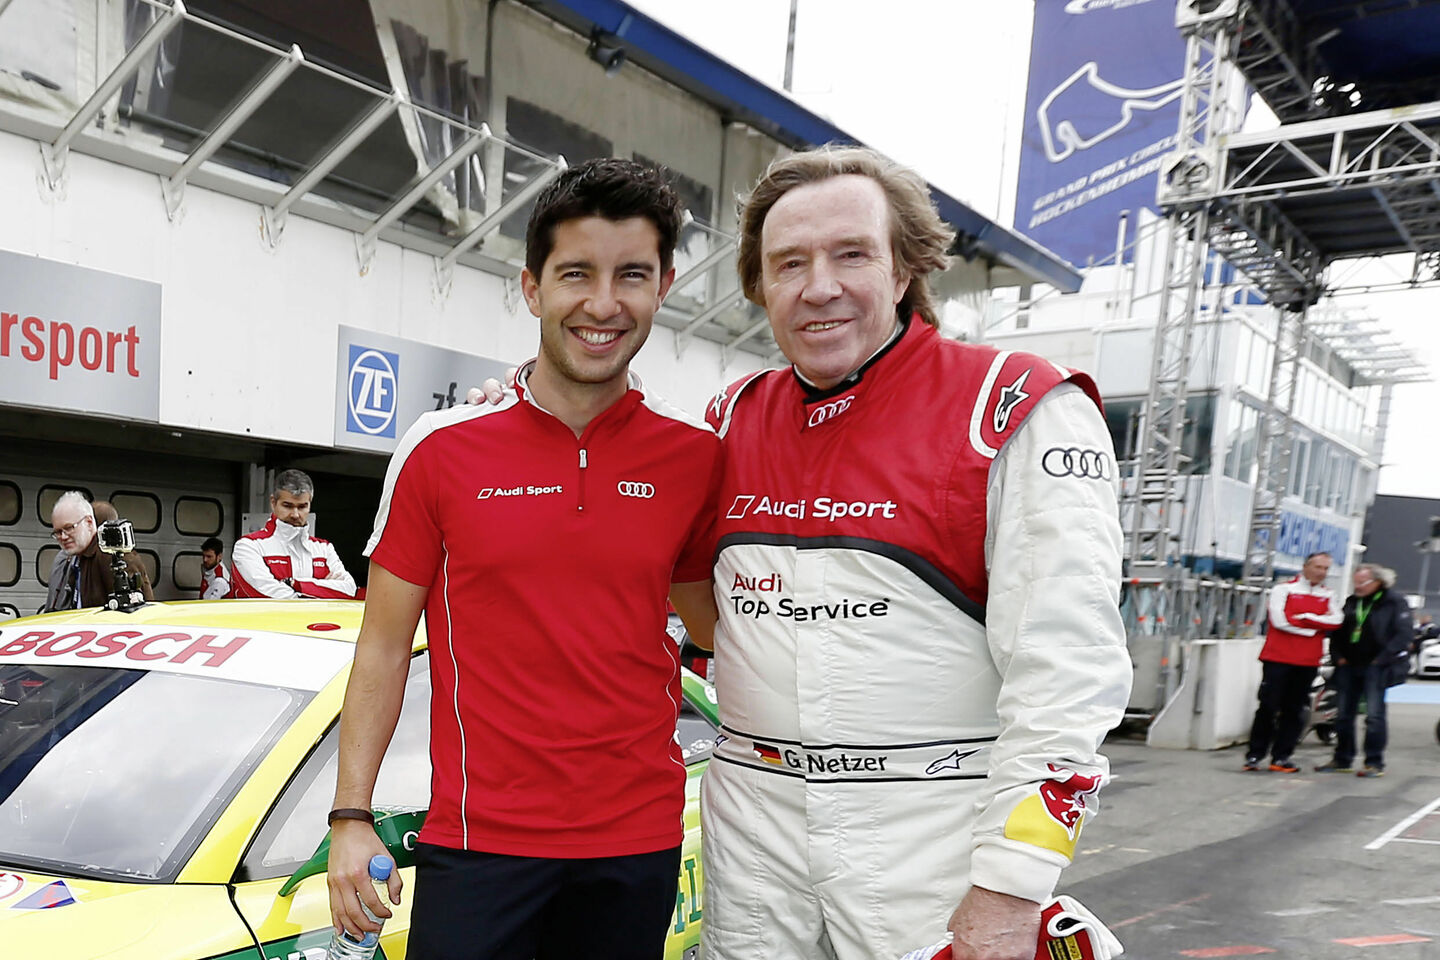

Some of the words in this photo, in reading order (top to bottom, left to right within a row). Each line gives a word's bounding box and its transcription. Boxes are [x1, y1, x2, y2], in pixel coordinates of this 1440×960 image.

[353, 365, 394, 419] ZF
[493, 487, 524, 497] Audi
[526, 485, 563, 498] Sport
[753, 496, 806, 520] Audi
[812, 497, 897, 522] Sport
[731, 573, 783, 593] Audi
[730, 595, 770, 619] Top
[776, 598, 890, 622] Service
[784, 749, 802, 769] G
[806, 753, 888, 774] Netzer
